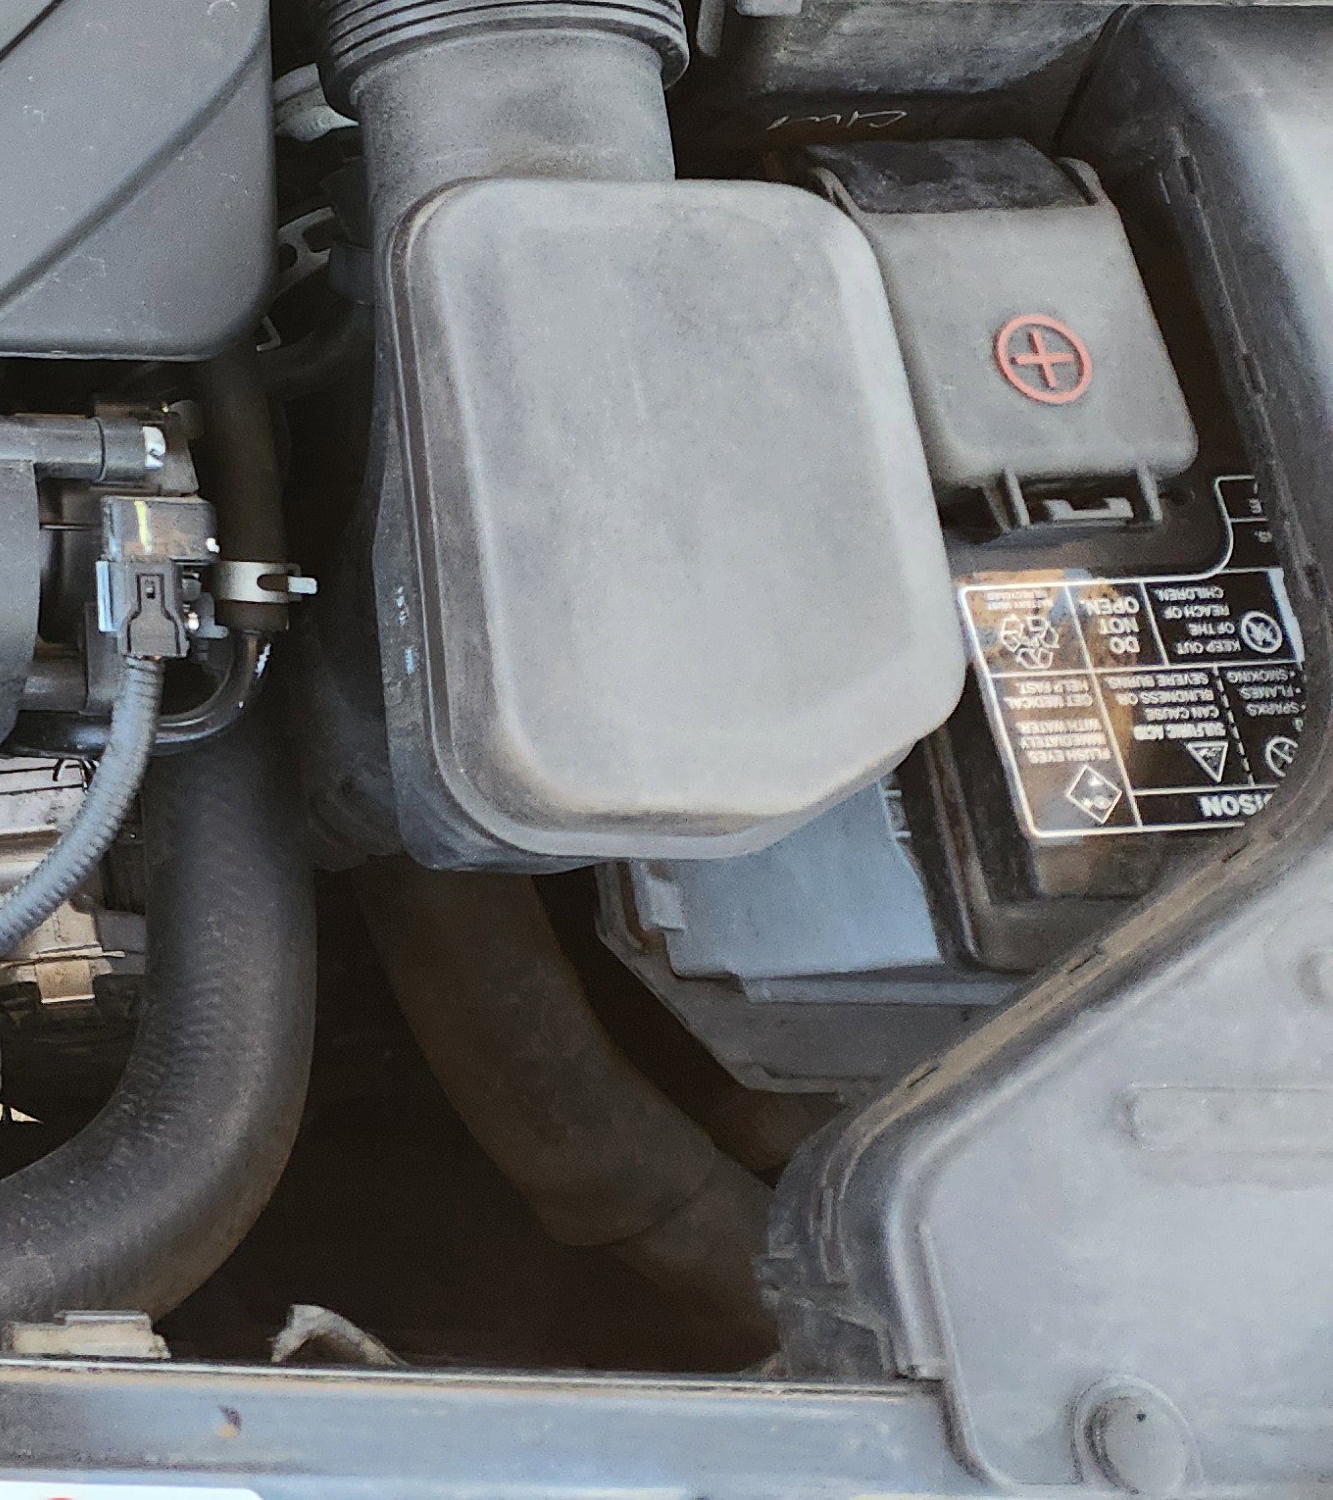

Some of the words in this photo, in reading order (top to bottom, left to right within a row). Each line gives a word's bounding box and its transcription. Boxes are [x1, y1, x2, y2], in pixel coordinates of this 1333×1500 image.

[1164, 606, 1184, 618] OF
[1187, 603, 1229, 616] REACH
[1098, 617, 1139, 634] NOT
[1188, 623, 1214, 635] THE
[1216, 622, 1235, 635] OF
[1110, 636, 1139, 653] DO
[1178, 640, 1204, 654] OUT
[1205, 639, 1240, 652] KEEP
[1157, 672, 1208, 686] SEVERE
[1227, 669, 1288, 682] SMOKING
[1058, 679, 1088, 693] HELP
[1004, 696, 1063, 710] MEDICAL
[1065, 693, 1092, 707] GET
[1019, 734, 1106, 748] IMMEDIATELY
[1064, 748, 1110, 762] FLUSH
